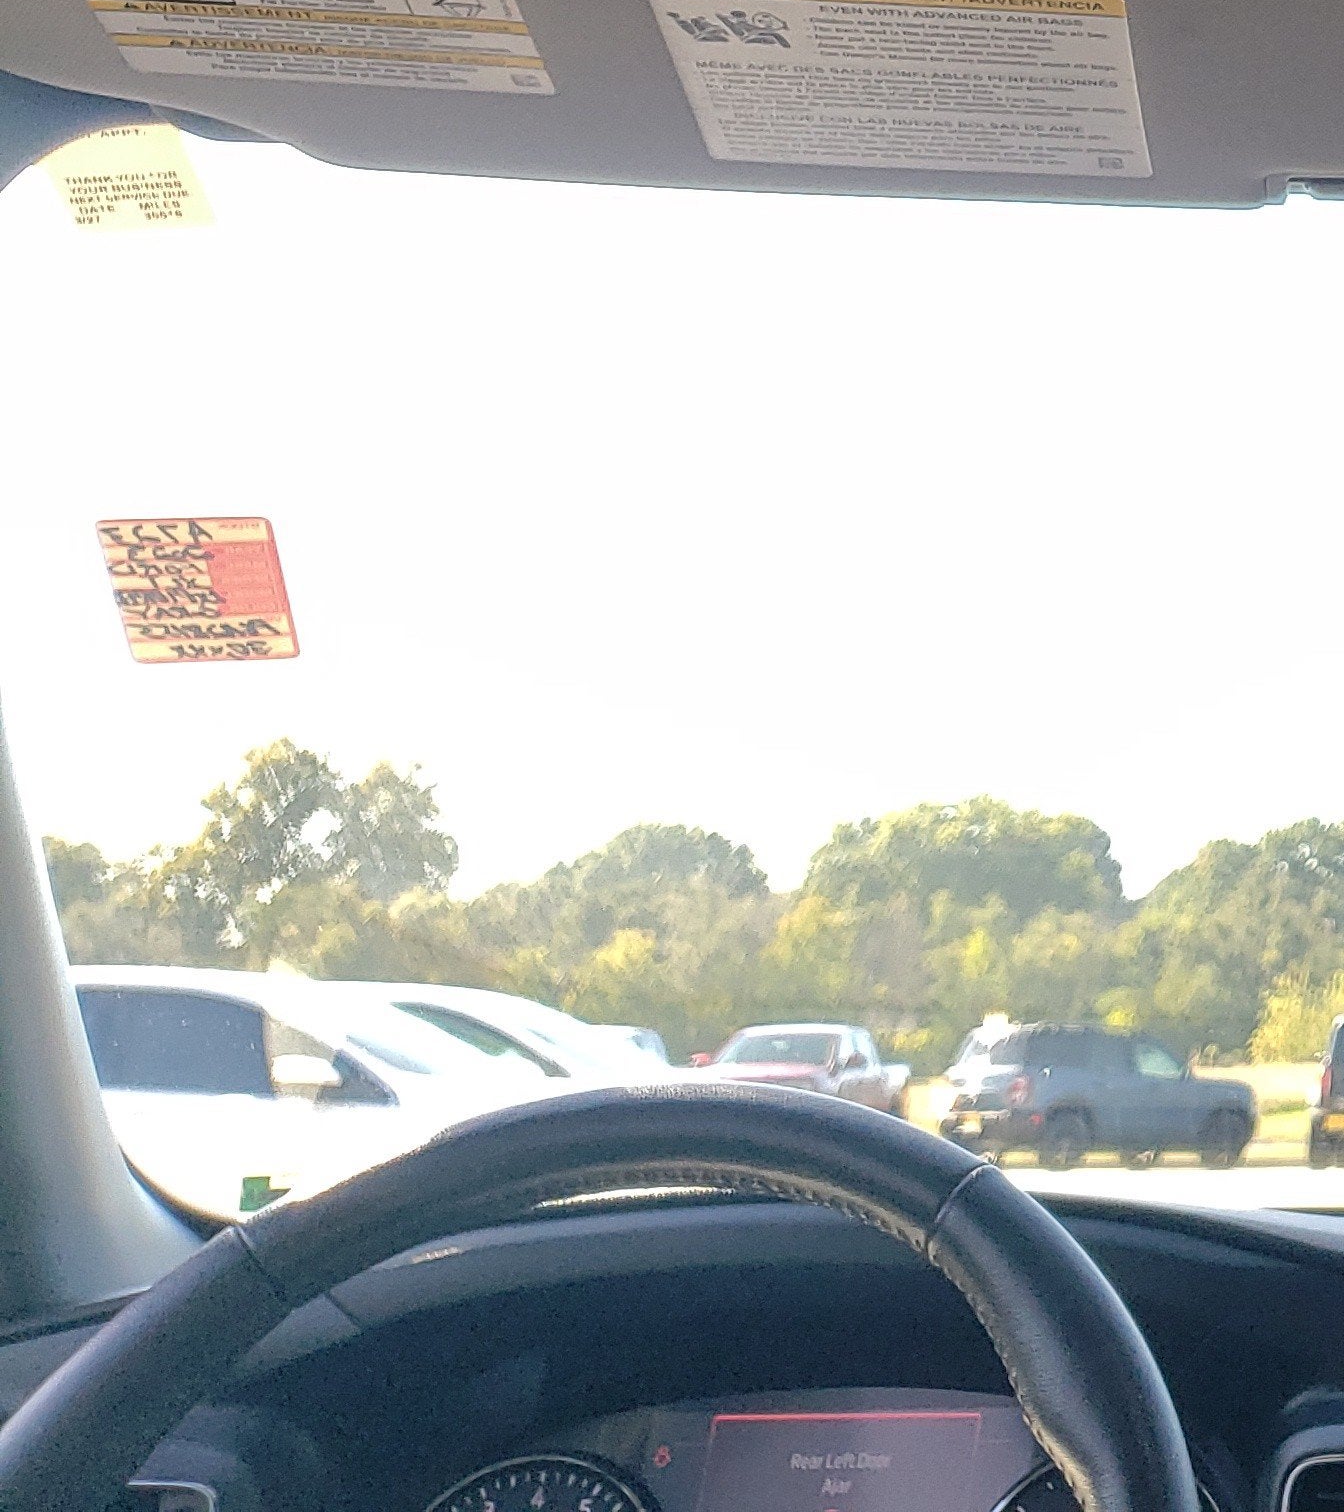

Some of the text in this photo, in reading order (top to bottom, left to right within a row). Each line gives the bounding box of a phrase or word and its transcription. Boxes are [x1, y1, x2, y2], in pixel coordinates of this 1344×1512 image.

[912, 9, 1002, 23] ADVANCED
[1006, 15, 1034, 25] AIR
[790, 1452, 891, 1470] Rear Left Door
[530, 1488, 545, 1509] 4
